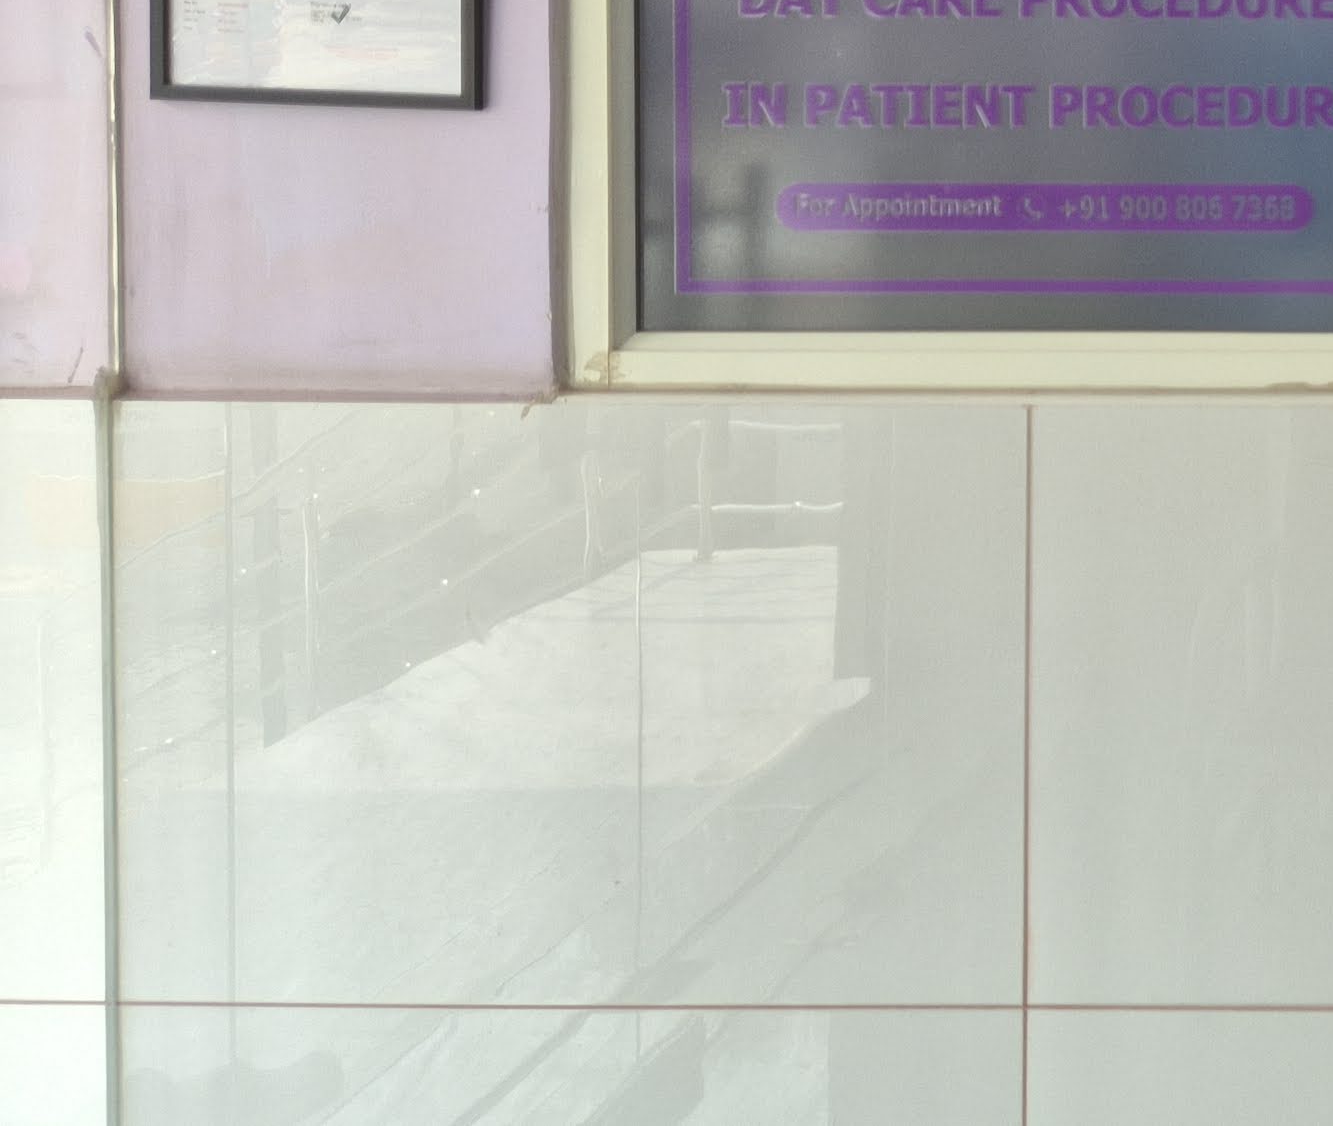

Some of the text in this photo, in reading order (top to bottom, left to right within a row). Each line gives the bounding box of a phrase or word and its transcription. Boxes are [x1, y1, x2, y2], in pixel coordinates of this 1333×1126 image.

[724, 83, 787, 127] IN
[805, 83, 1034, 128] PATIENT
[794, 192, 1296, 222] For Appointment +91 900 806 7368
